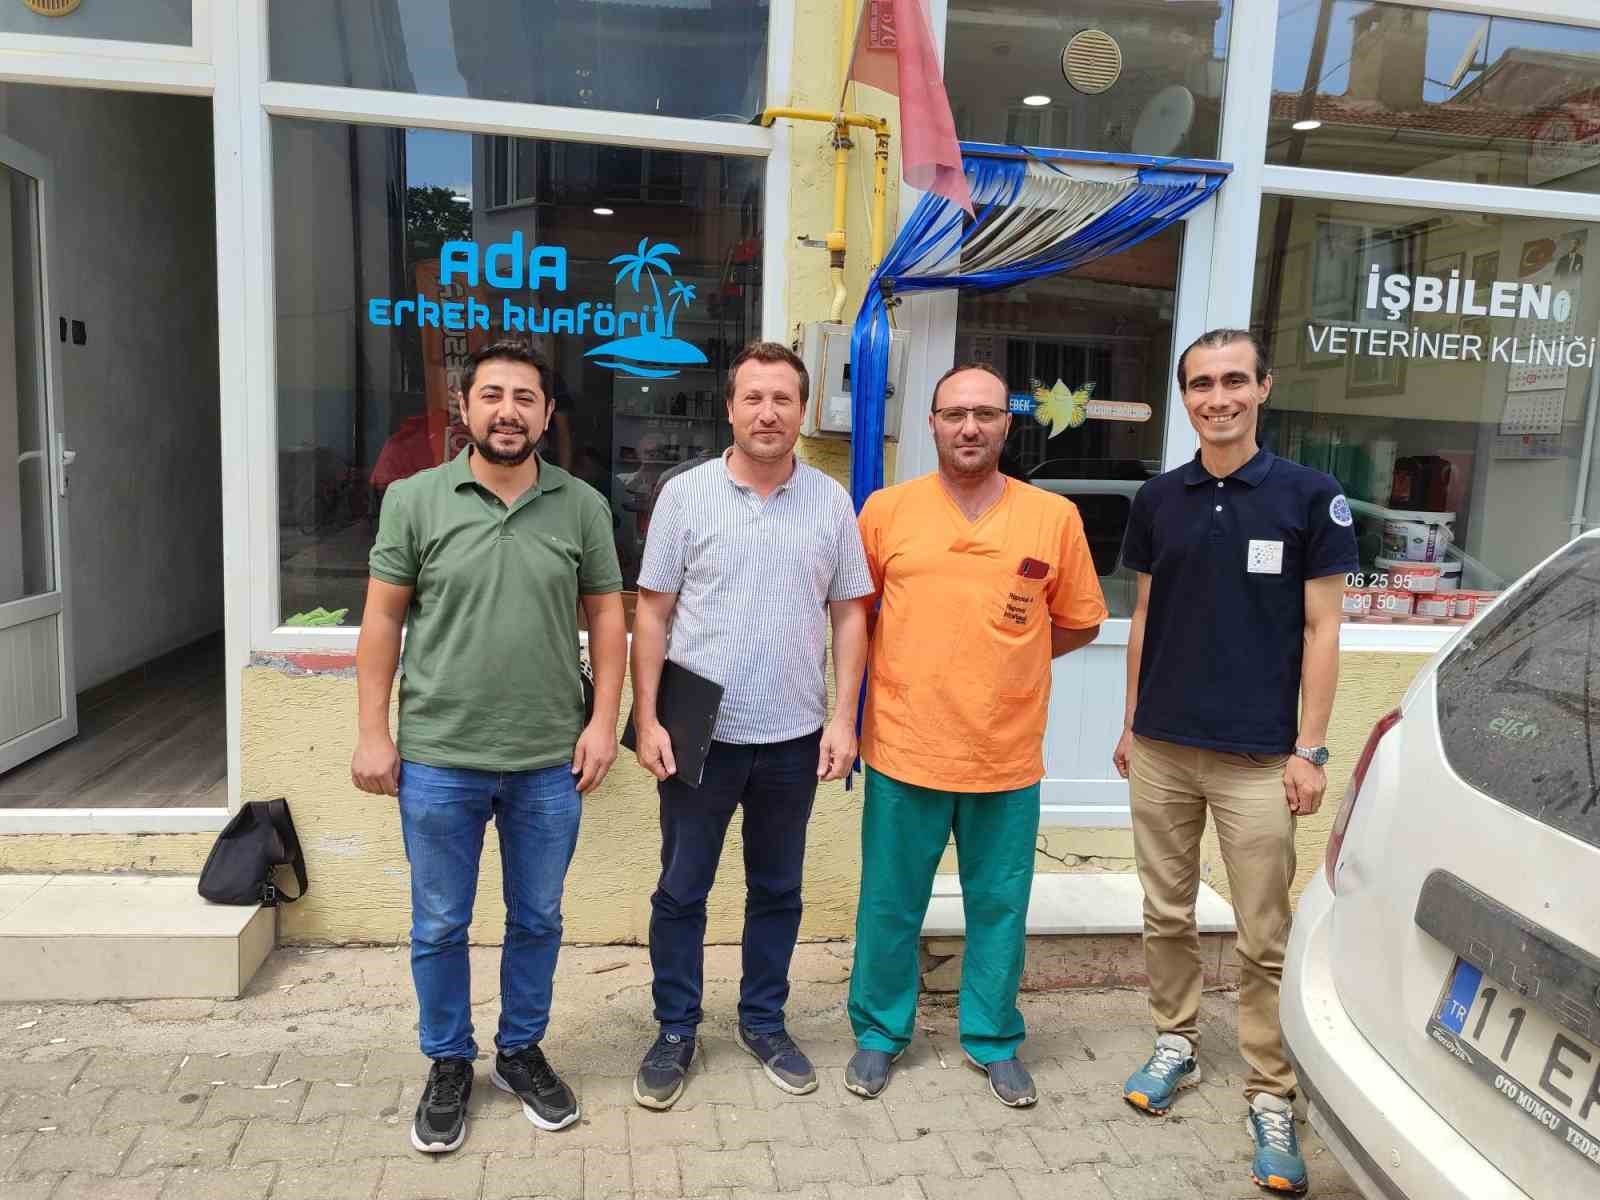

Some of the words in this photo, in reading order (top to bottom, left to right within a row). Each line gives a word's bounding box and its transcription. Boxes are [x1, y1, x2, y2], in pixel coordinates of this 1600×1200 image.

[1366, 264, 1552, 320] İŞBİLEN
[1308, 325, 1481, 362] VETERİNER
[1490, 333, 1596, 369] KLİNİĞİ
[1345, 572, 1364, 588] 06
[1369, 573, 1389, 589] 25
[1393, 574, 1412, 589] 95
[1353, 594, 1371, 609] 30
[1377, 594, 1396, 609] 50
[1452, 1000, 1467, 1025] TR
[1473, 987, 1526, 1063] 11
[1494, 1075, 1518, 1098] OTO
[1515, 1090, 1561, 1130] MUMCU
[1565, 1126, 1600, 1166] YEDE
